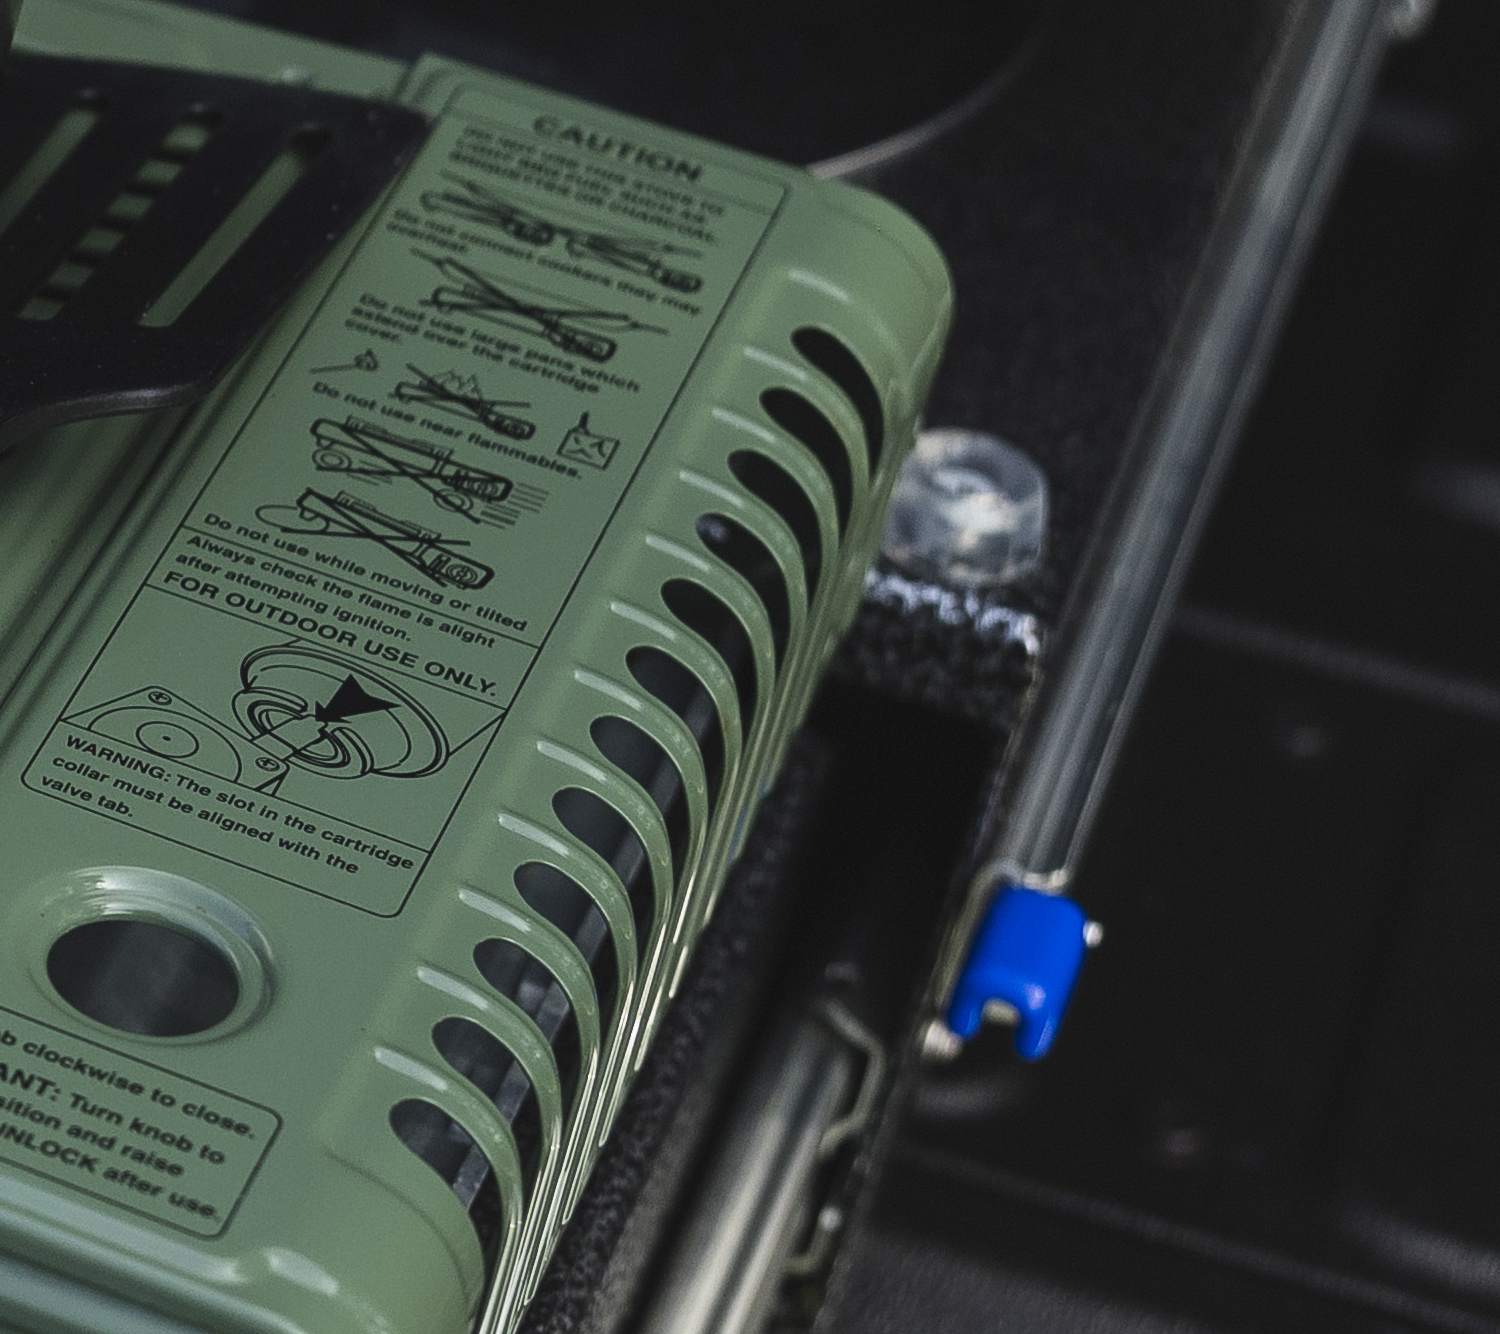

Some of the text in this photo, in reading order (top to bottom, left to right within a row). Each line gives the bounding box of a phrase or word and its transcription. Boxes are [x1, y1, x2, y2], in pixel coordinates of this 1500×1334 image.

[533, 116, 702, 183] CAUTION
[359, 293, 640, 393] Do not use large pans which
[472, 344, 505, 362] the
[508, 358, 600, 394] cartridge
[312, 381, 582, 479] Do not use near flammables.
[175, 554, 411, 642] after attempting ignition.
[186, 529, 496, 649] Always check the flame is alight
[203, 513, 528, 632] Do not use while moving or tilted
[163, 570, 497, 697] FOR OUTDOOR USE ONLY.
[42, 775, 133, 818] valve tab.
[52, 757, 359, 874] collar must be aligned with the
[66, 734, 414, 870] WARNING: The slot in the cartridge
[22, 1042, 145, 1096] clockwise
[150, 1088, 177, 1108] to
[181, 1102, 254, 1139] close.
[70, 1092, 124, 1126] Turn
[128, 1117, 194, 1153] knob
[199, 1144, 226, 1165] to
[66, 1124, 117, 1151] and
[120, 1145, 184, 1177] raise
[102, 1167, 163, 1196] after
